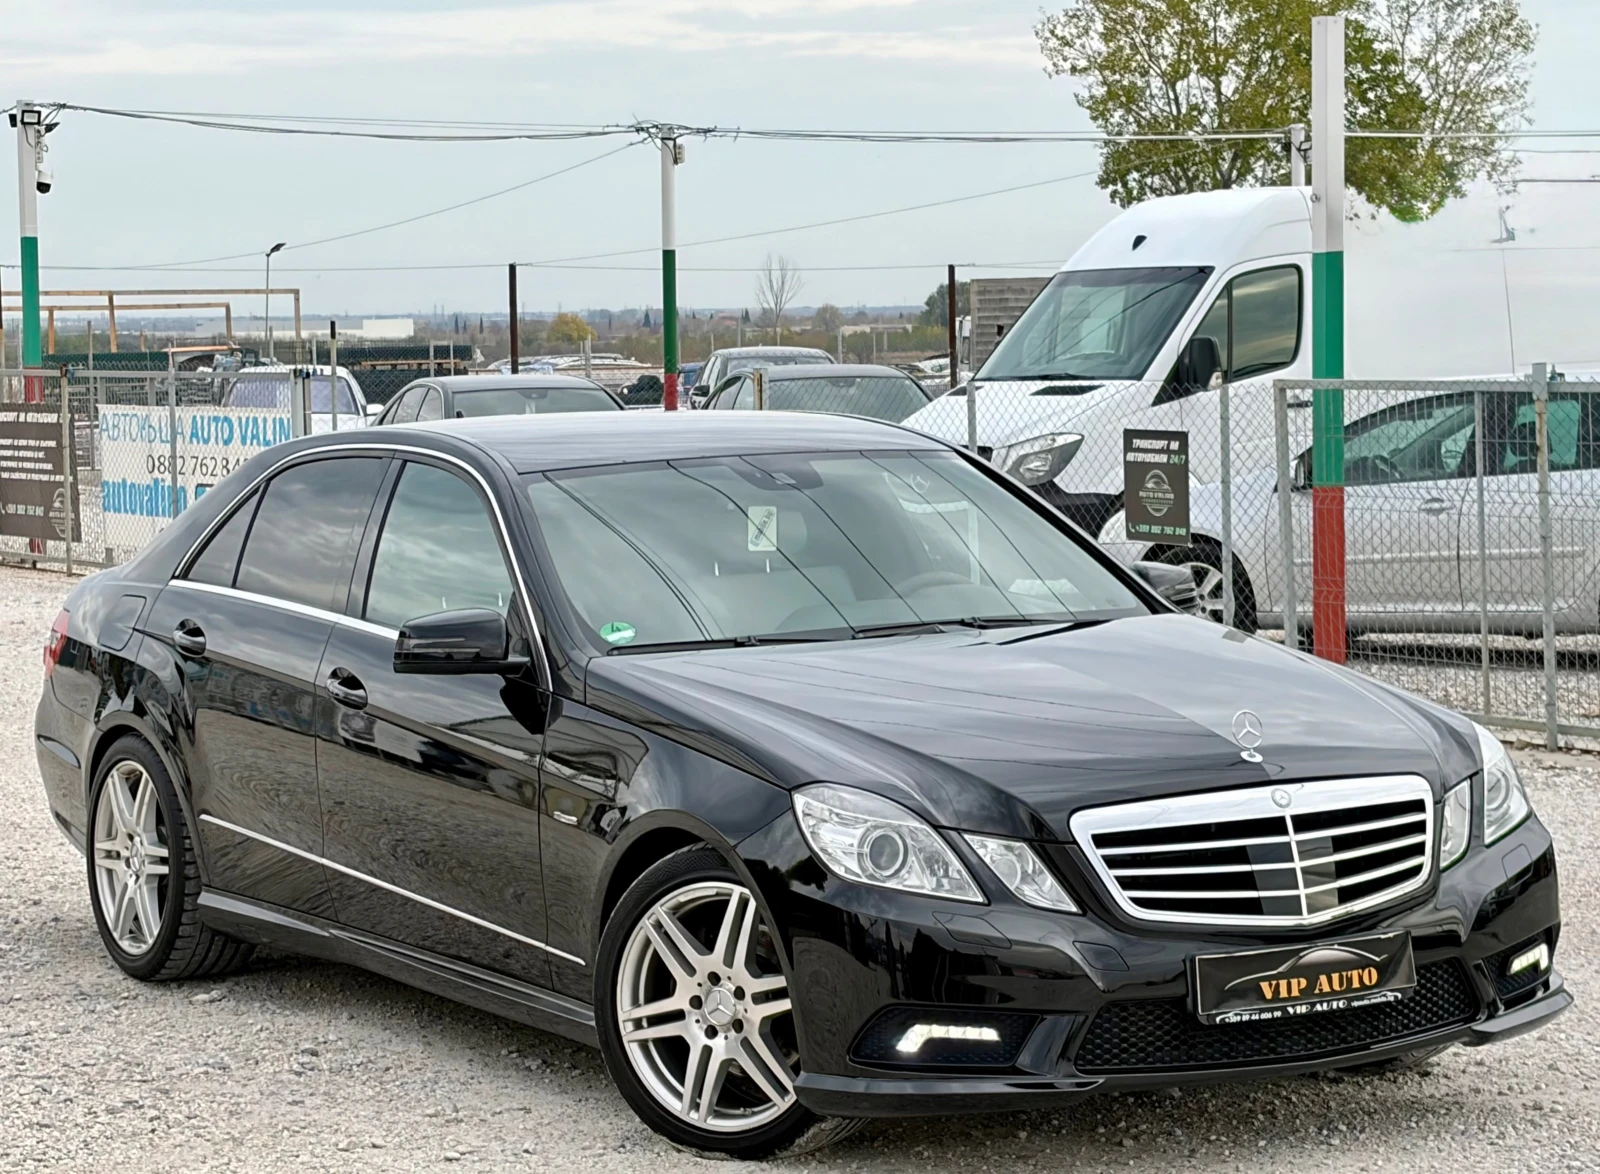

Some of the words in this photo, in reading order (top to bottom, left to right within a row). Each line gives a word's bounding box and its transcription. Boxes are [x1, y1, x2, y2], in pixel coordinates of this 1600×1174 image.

[189, 415, 234, 447] AUTO
[1132, 439, 1168, 450] ТРАНСПОРТ
[1170, 441, 1179, 450] НА
[1126, 452, 1168, 463] АВТОМОБИЛИ
[1169, 454, 1185, 465] 24/7
[1259, 977, 1308, 1000] VIP
[1313, 966, 1379, 994] AUTO
[1286, 1004, 1311, 1015] VIP
[1312, 999, 1348, 1012] AUTO
